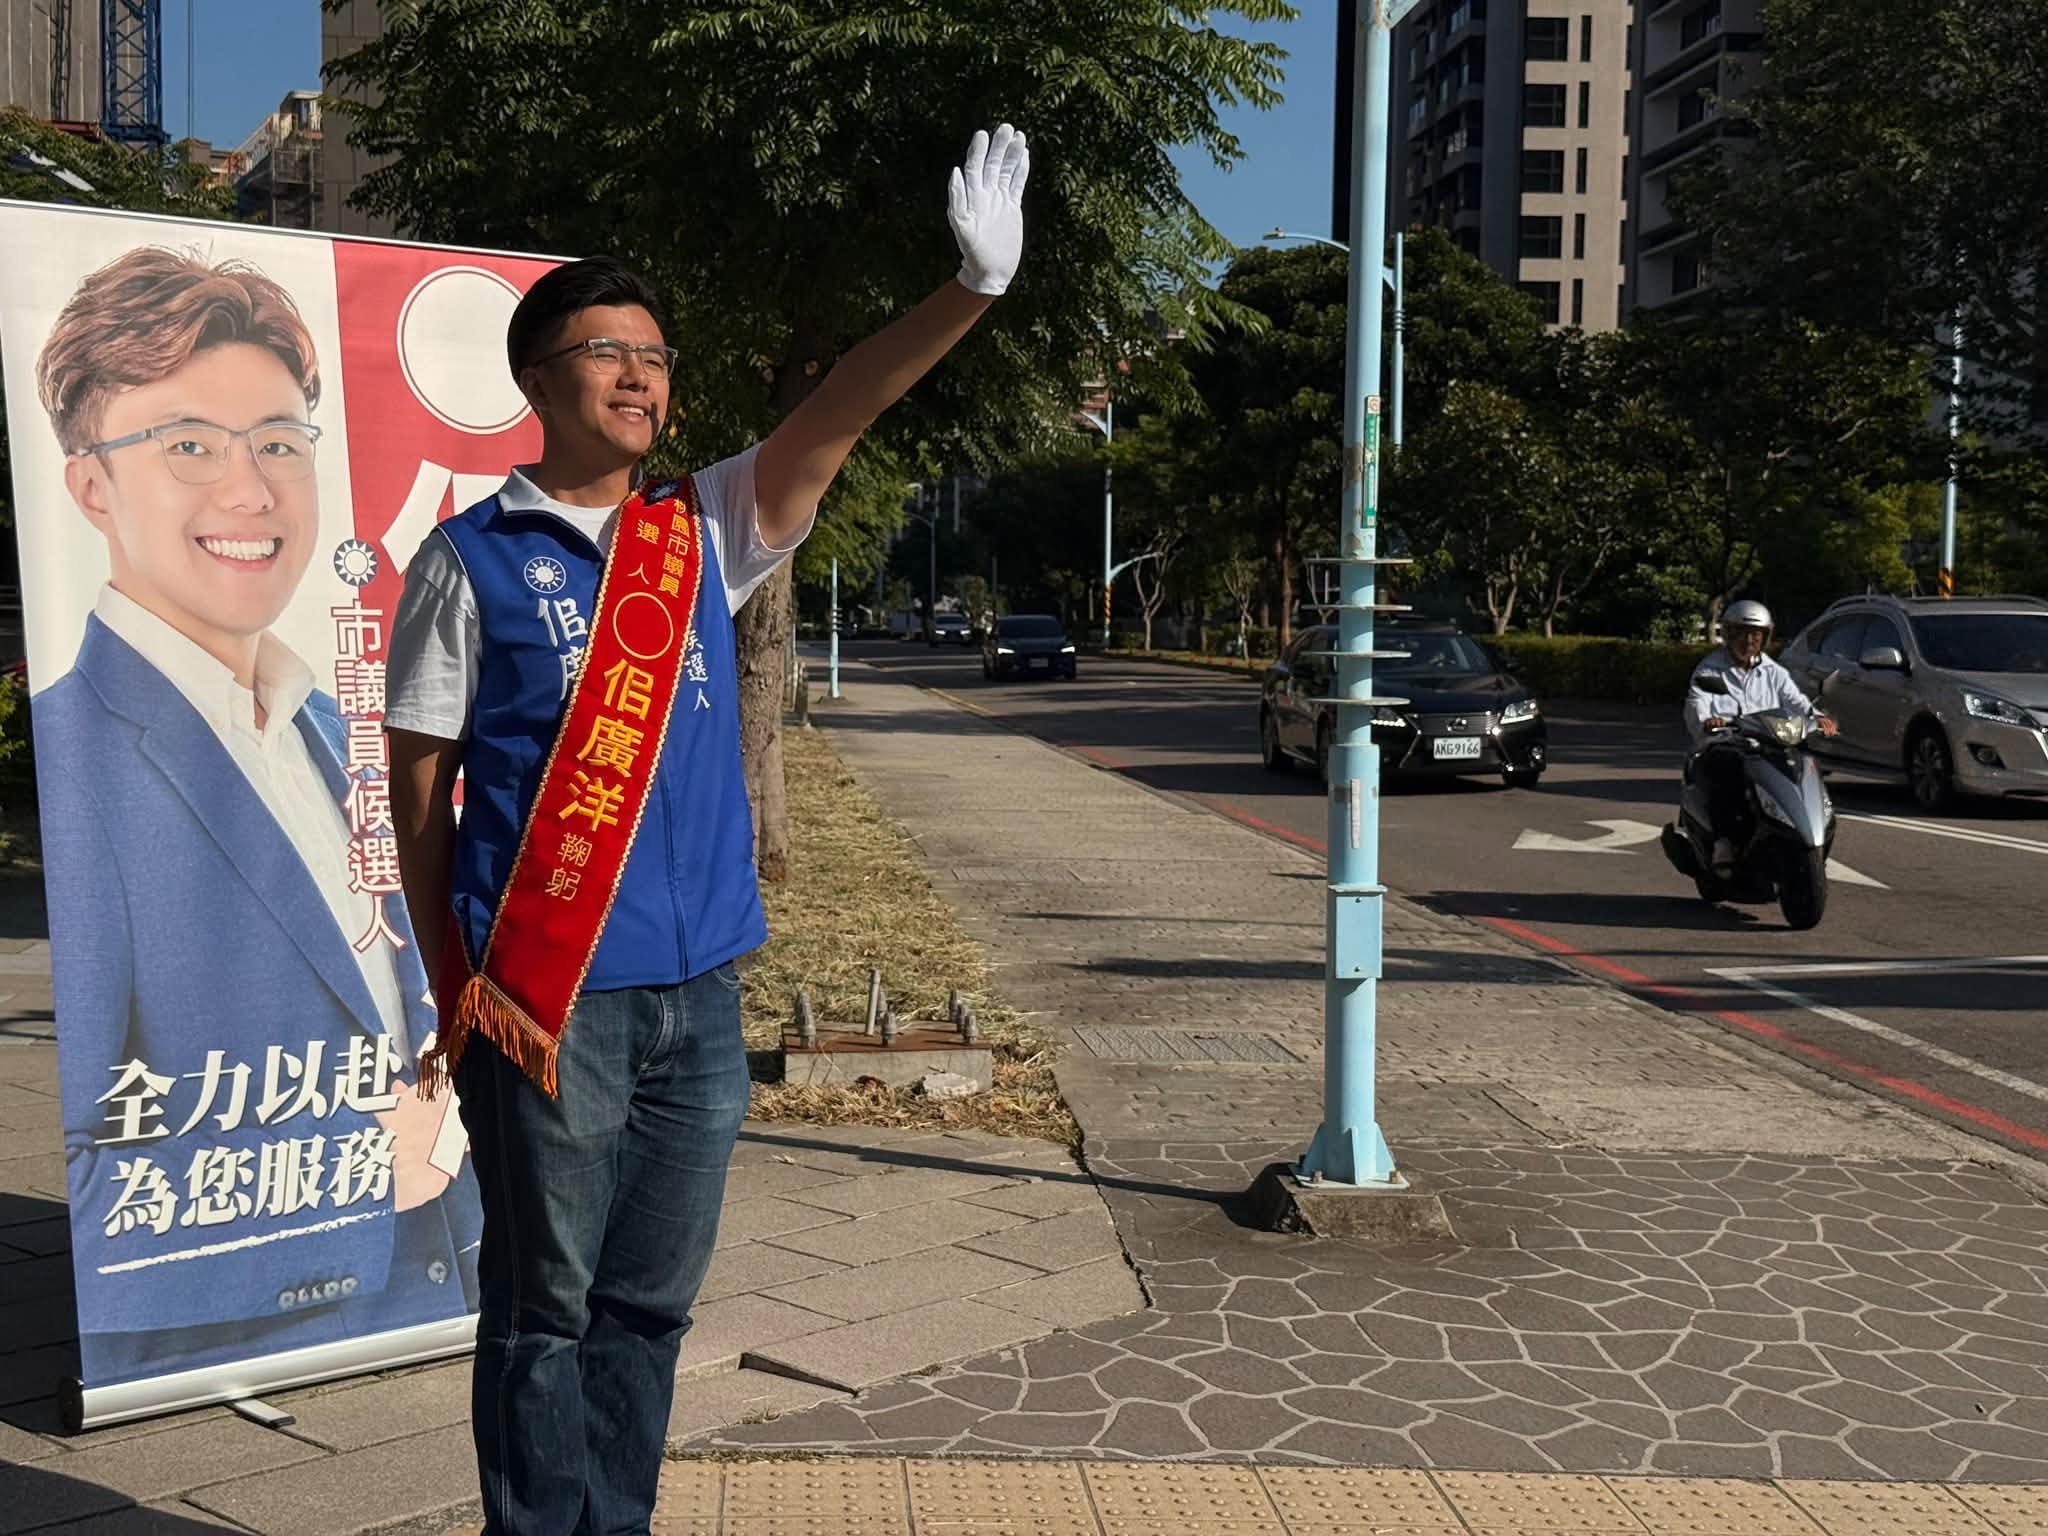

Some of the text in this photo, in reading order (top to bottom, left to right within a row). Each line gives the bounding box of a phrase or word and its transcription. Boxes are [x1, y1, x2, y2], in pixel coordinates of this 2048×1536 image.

[331, 599, 408, 952] 市議員候選人
[545, 832, 593, 901] 鞠躬
[95, 1034, 404, 1145] 全力以赴
[103, 1127, 398, 1237] 為您服務
